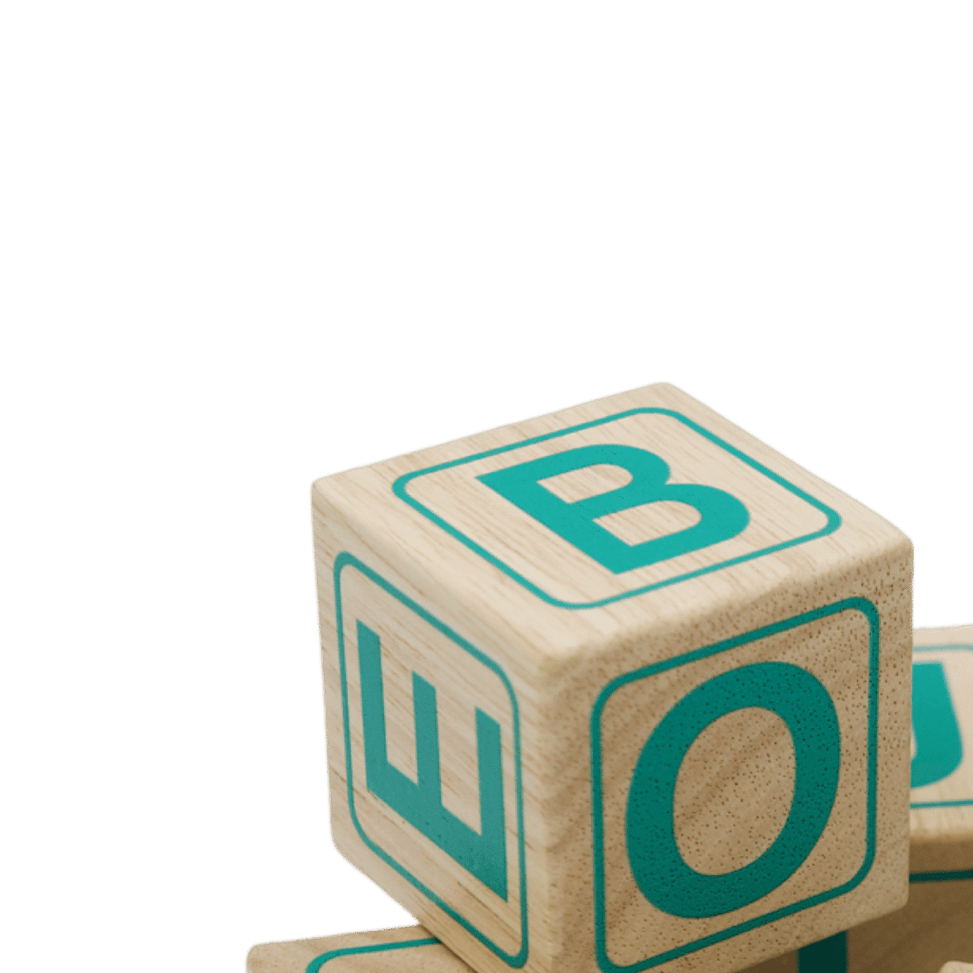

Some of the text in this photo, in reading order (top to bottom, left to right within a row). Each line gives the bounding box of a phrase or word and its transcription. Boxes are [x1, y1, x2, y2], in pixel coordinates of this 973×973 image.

[477, 444, 750, 575] B
[357, 621, 508, 902] E
[625, 661, 841, 919] O
